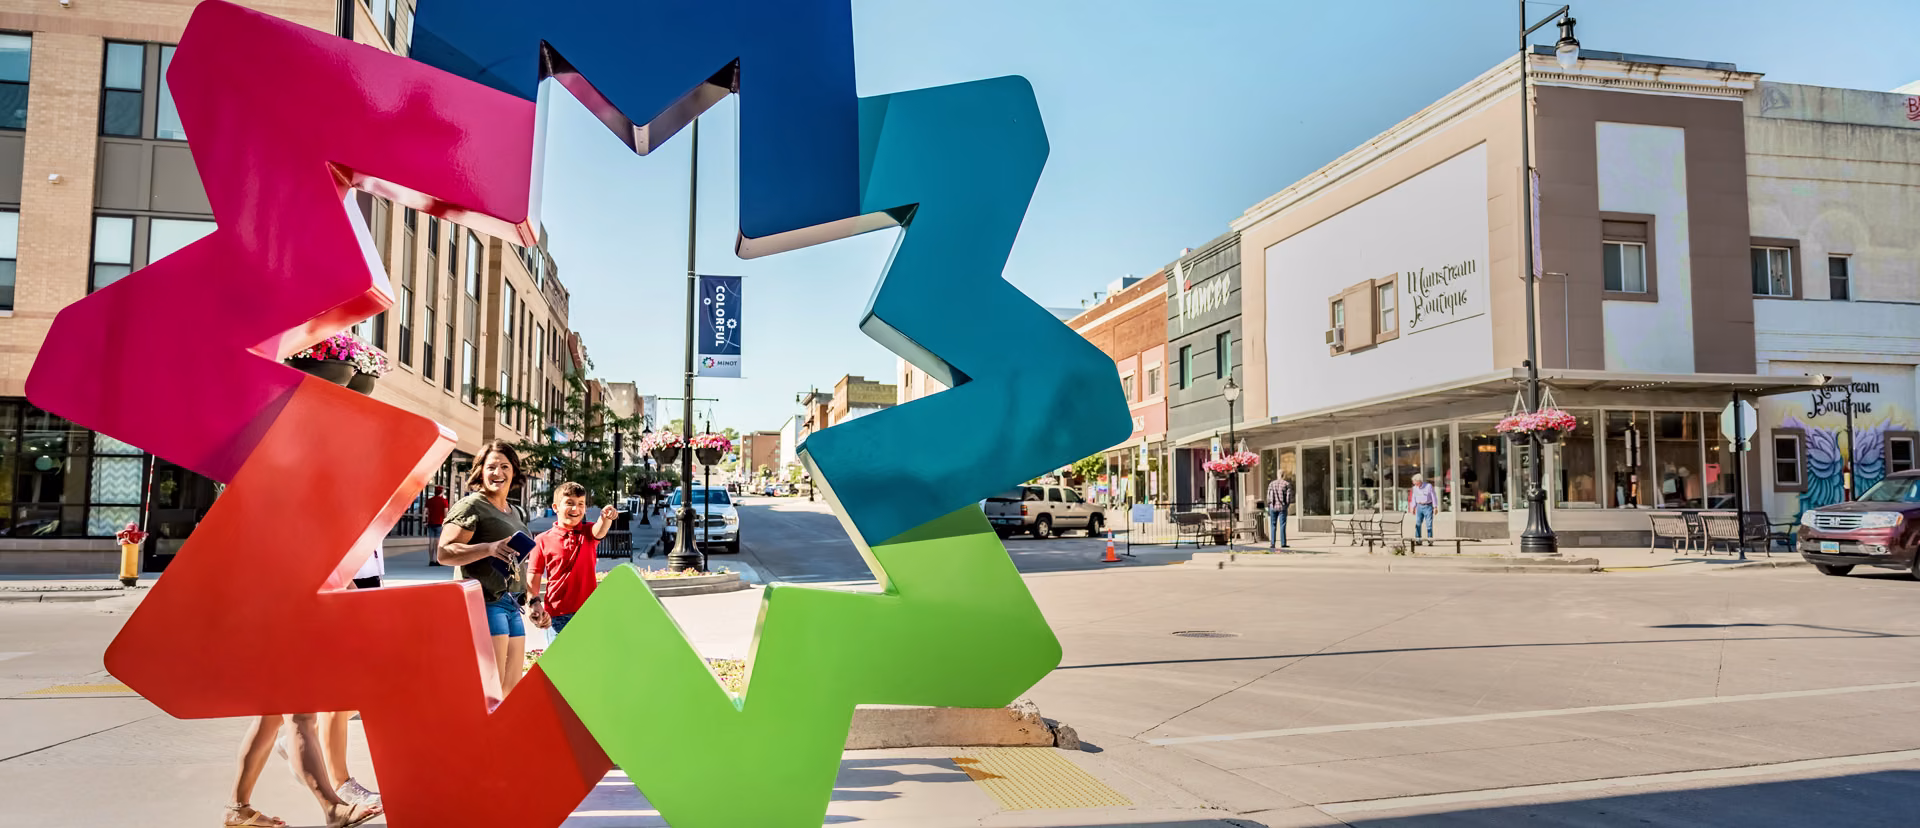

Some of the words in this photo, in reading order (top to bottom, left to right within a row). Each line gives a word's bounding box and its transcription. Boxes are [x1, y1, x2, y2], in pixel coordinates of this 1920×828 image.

[1407, 259, 1476, 298] Mainstream
[715, 285, 726, 347] COLORFUL
[1409, 289, 1468, 329] Boutique
[1807, 394, 1872, 419] Boutque
[1811, 382, 1880, 399] ainstream
